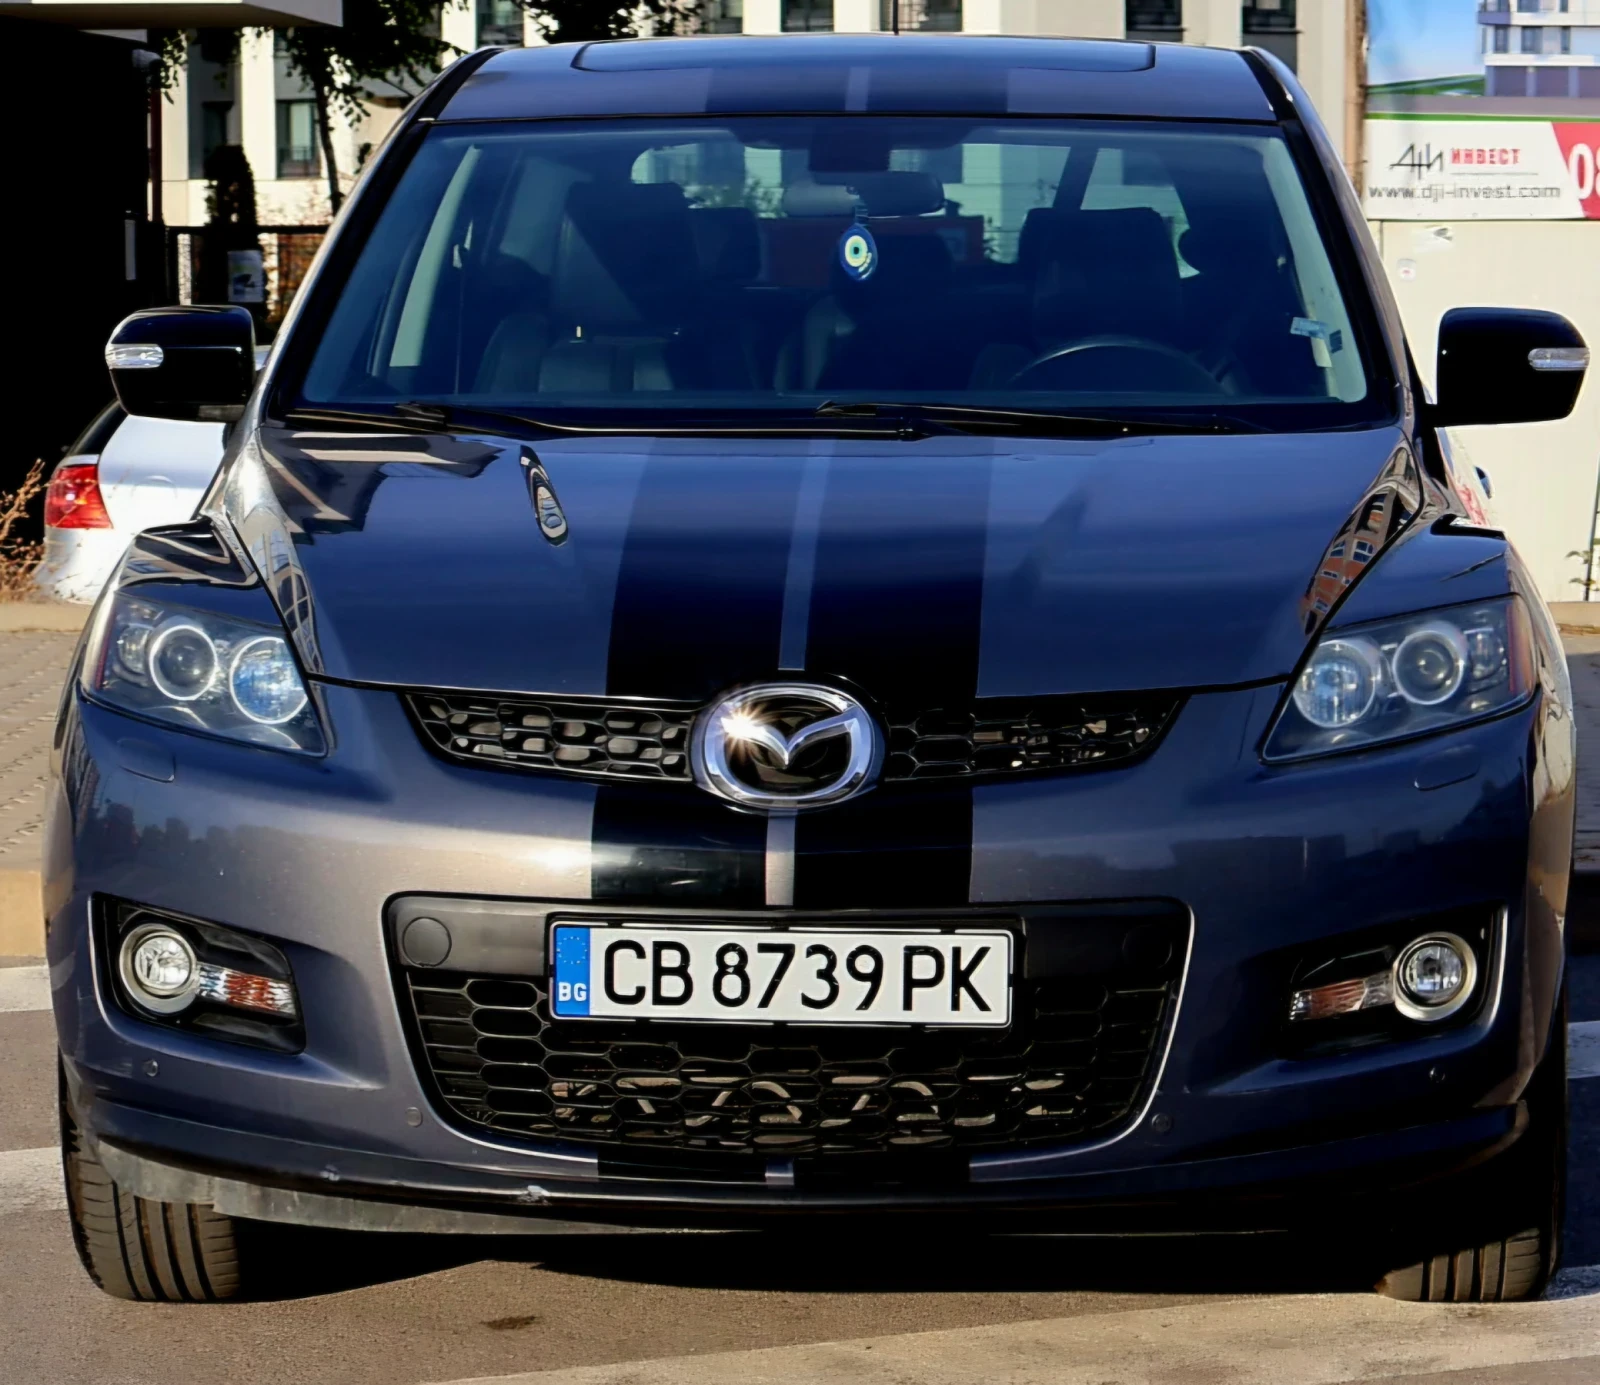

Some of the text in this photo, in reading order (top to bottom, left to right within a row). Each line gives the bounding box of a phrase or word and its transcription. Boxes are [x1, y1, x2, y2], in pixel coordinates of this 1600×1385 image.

[1569, 143, 1600, 199] 0
[1369, 183, 1561, 202] www.dji-invest.com
[558, 981, 587, 1002] BG
[604, 939, 992, 1012] CB 8739 PK
